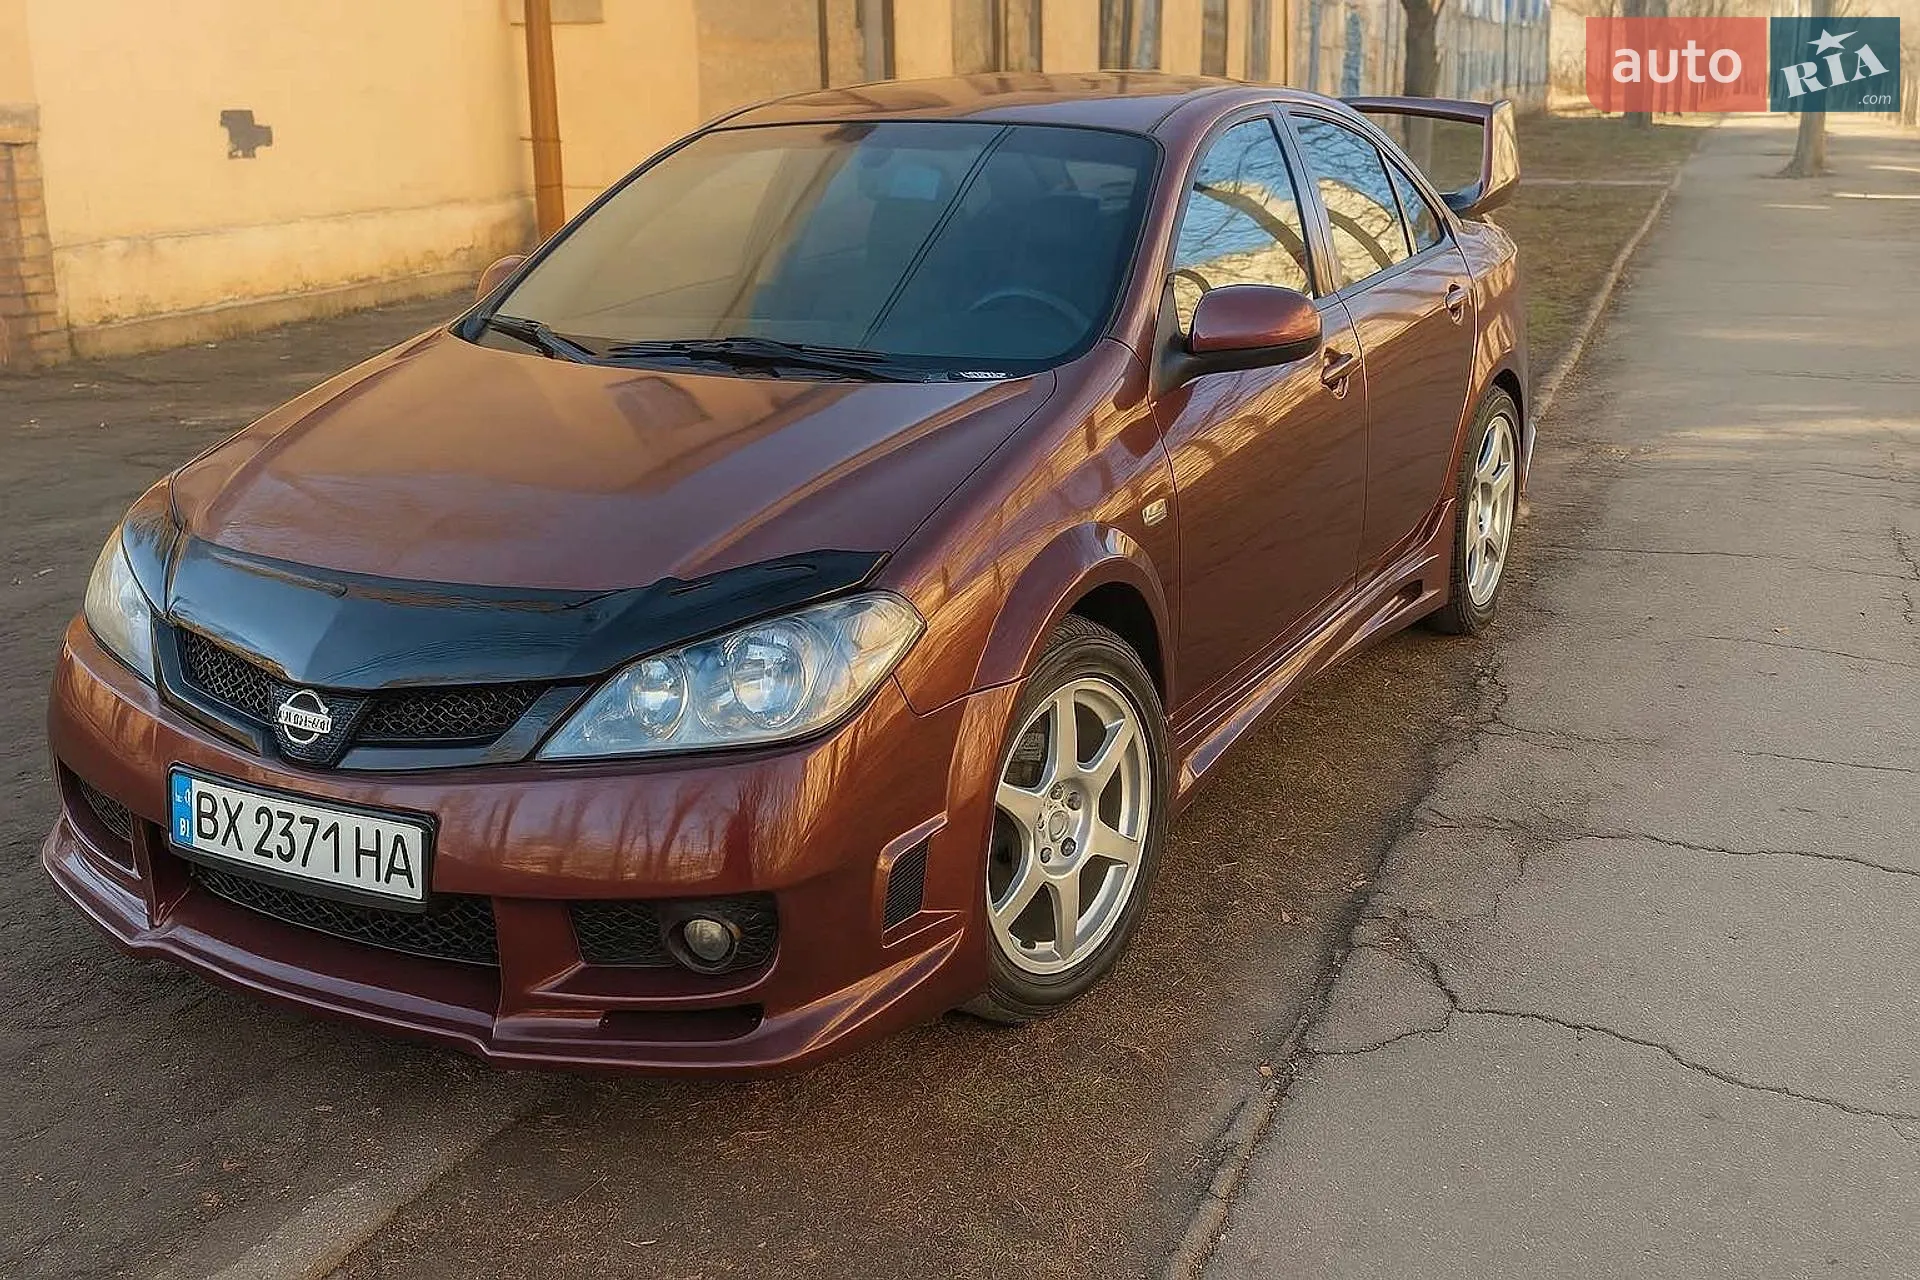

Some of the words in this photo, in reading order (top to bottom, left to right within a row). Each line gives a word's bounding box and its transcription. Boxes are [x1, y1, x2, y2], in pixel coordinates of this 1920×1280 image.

[196, 790, 244, 852] BX
[253, 806, 340, 873] 2371
[354, 826, 415, 889] HA
